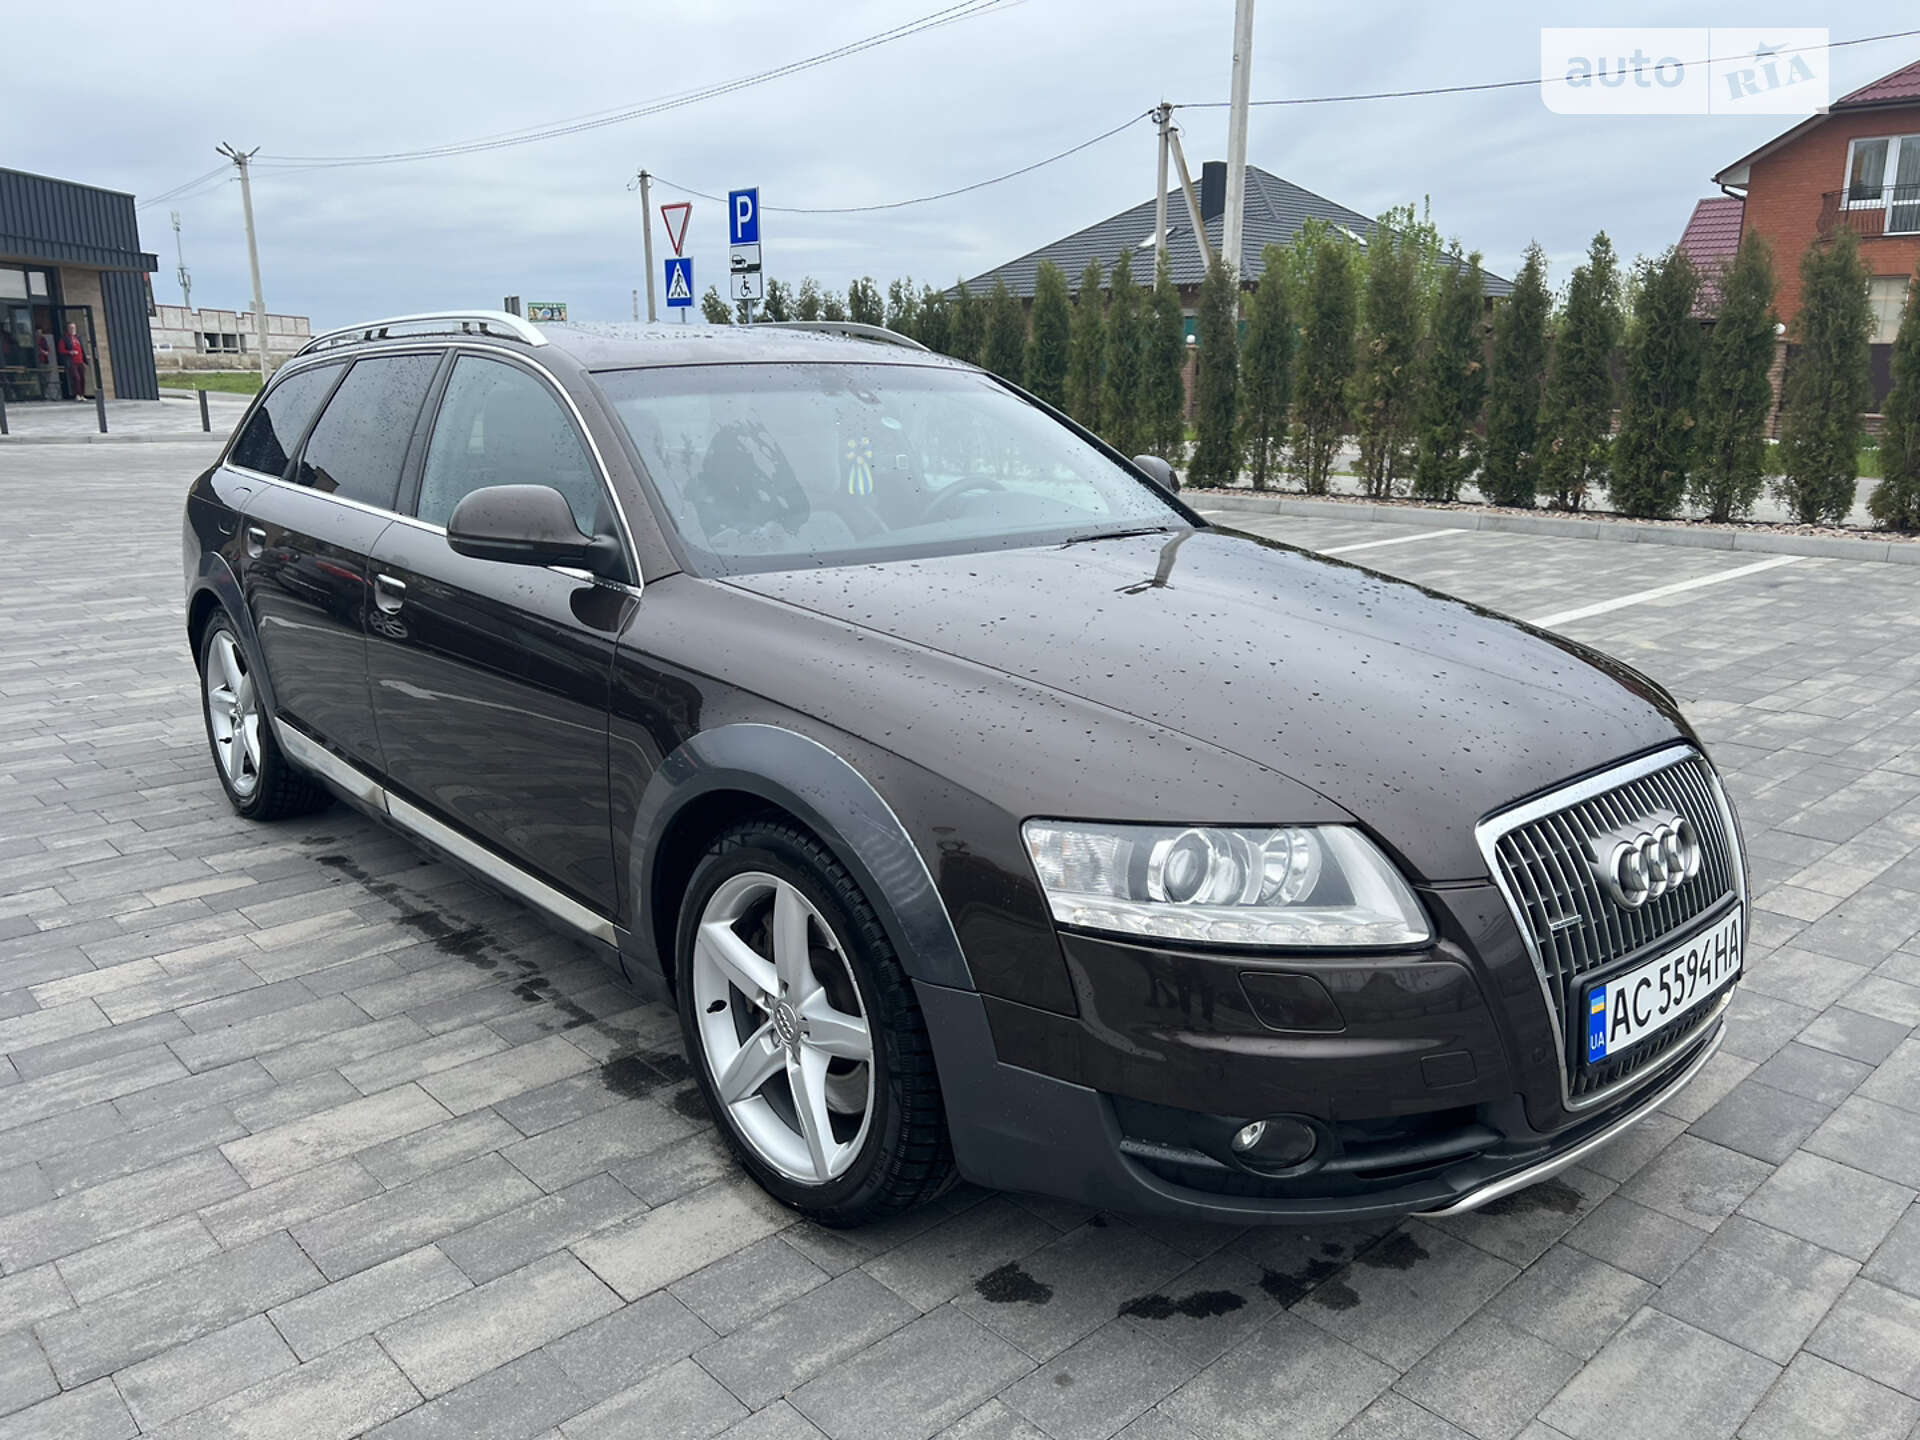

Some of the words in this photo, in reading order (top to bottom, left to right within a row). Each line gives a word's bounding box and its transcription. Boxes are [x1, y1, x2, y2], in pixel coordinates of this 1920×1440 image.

[736, 195, 752, 238] P
[1610, 977, 1651, 1042] AC
[1590, 1031, 1605, 1050] UA
